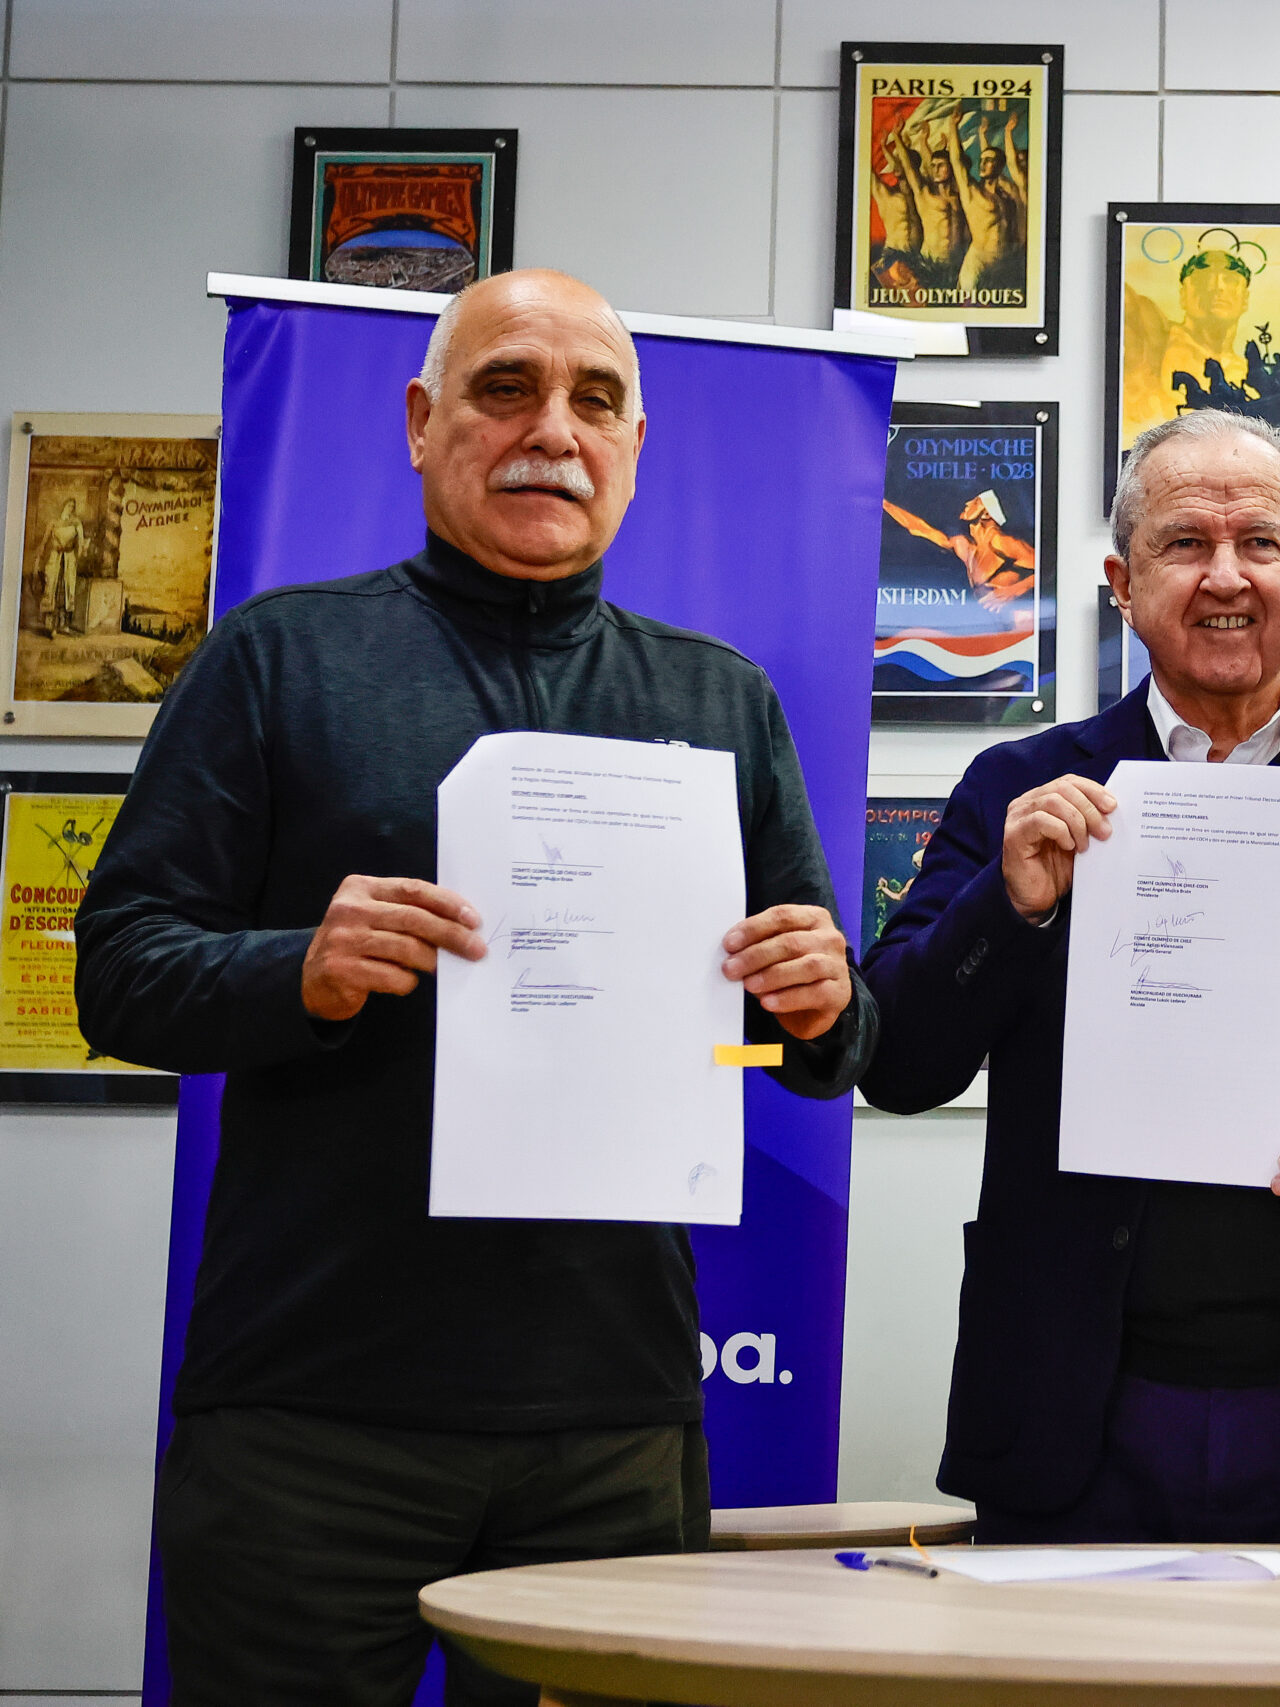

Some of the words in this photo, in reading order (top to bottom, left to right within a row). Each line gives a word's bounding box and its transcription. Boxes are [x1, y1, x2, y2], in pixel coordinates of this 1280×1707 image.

[871, 78, 955, 96] PARIS
[972, 79, 1033, 97] 1924
[870, 289, 911, 304] JEUX
[914, 289, 1025, 306] OLYMPIQUES
[904, 438, 1034, 457] OLYMPISCHE
[906, 461, 977, 480] SPIELE
[866, 809, 940, 824] OLYMPIC
[17, 1005, 73, 1016] SABRE
